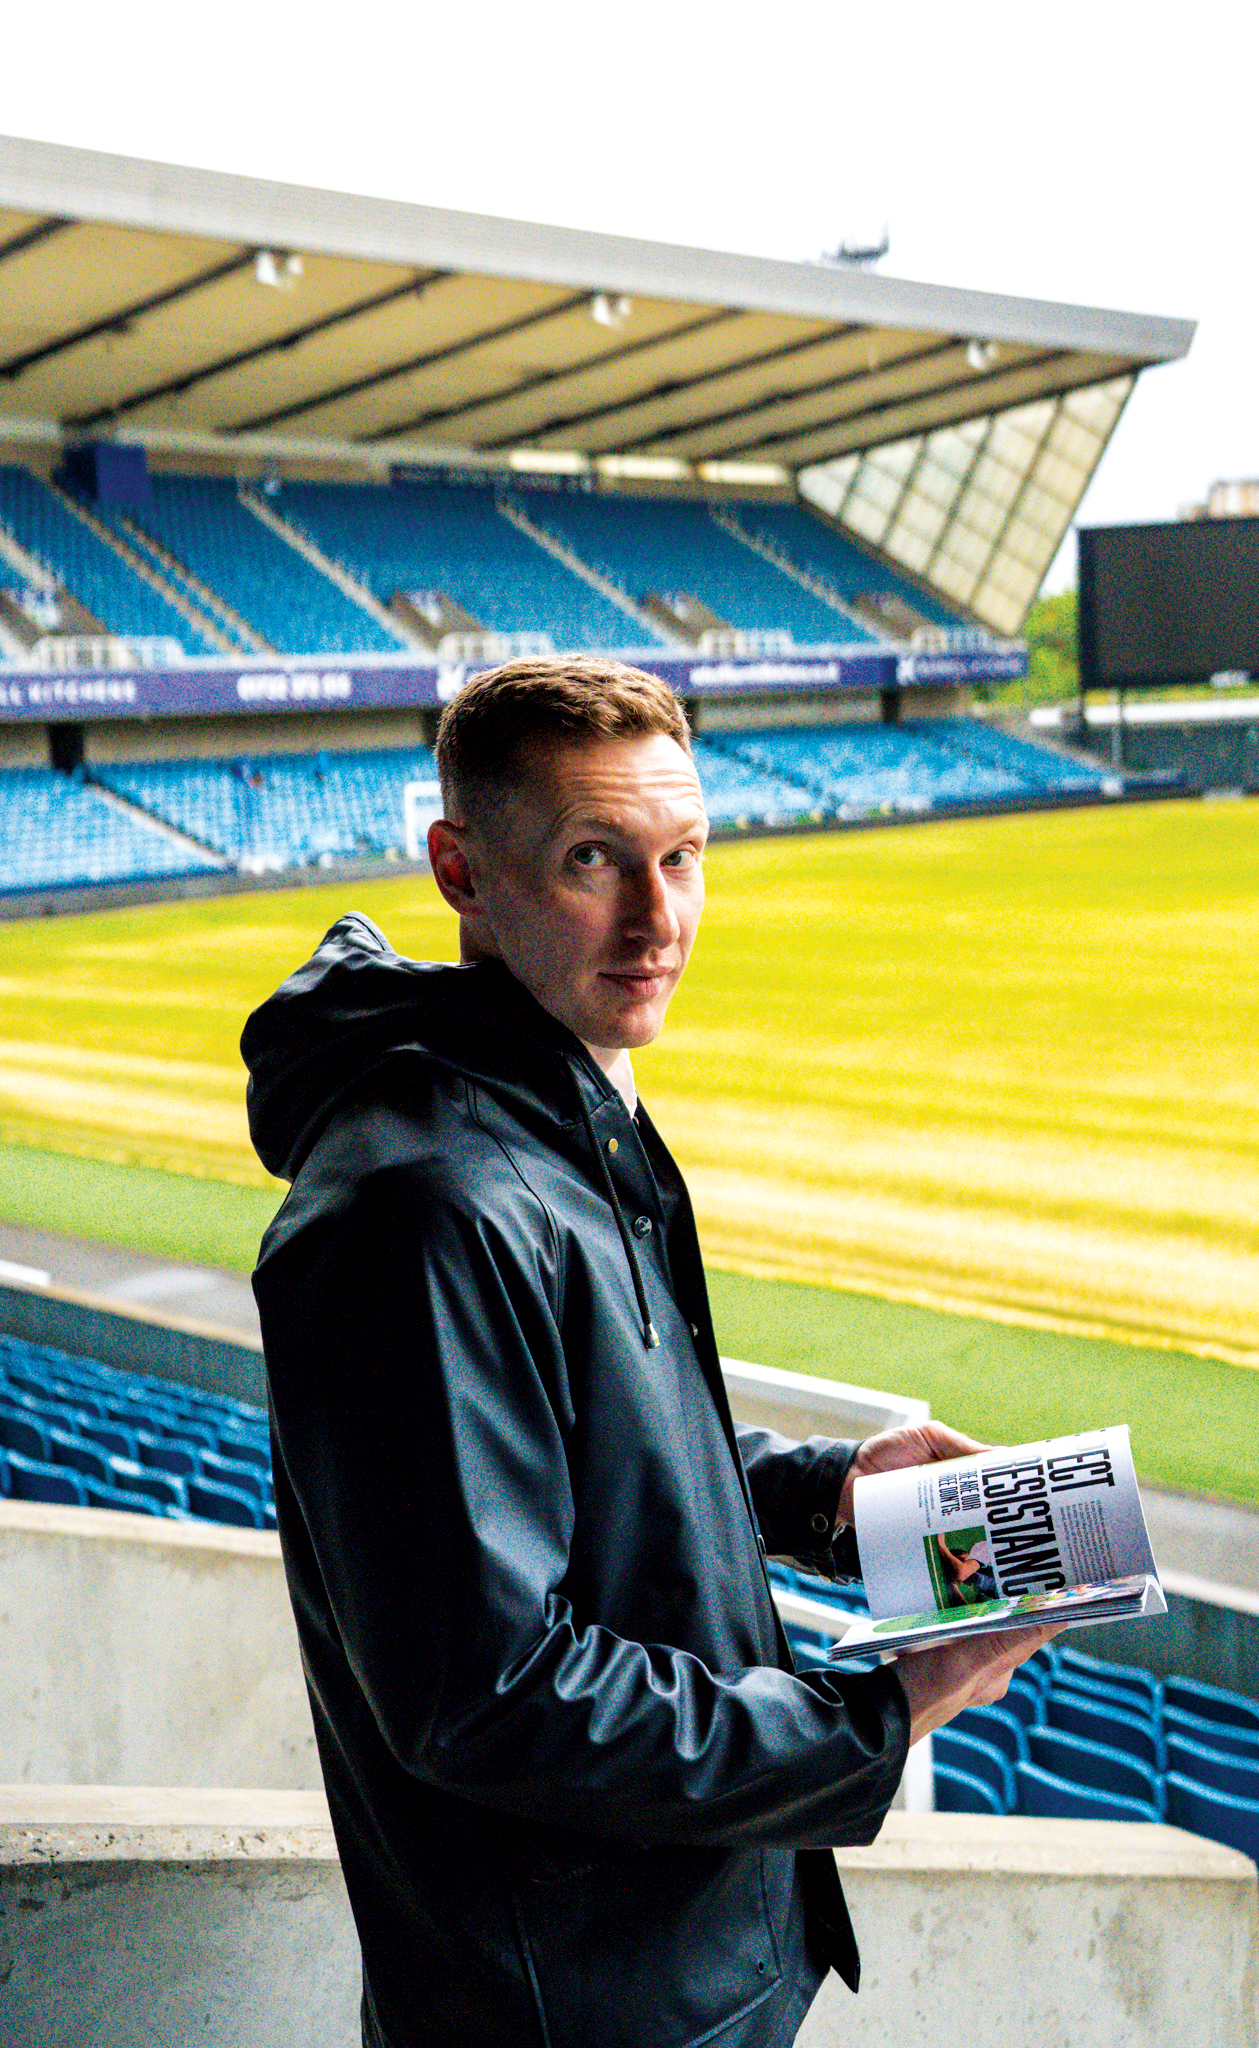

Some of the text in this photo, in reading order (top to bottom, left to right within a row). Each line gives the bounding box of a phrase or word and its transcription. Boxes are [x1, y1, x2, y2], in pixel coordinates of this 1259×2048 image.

[958, 1478, 979, 1495] ARE
[938, 1485, 961, 1517] DON'TS:
[960, 1492, 982, 1512] OUR
